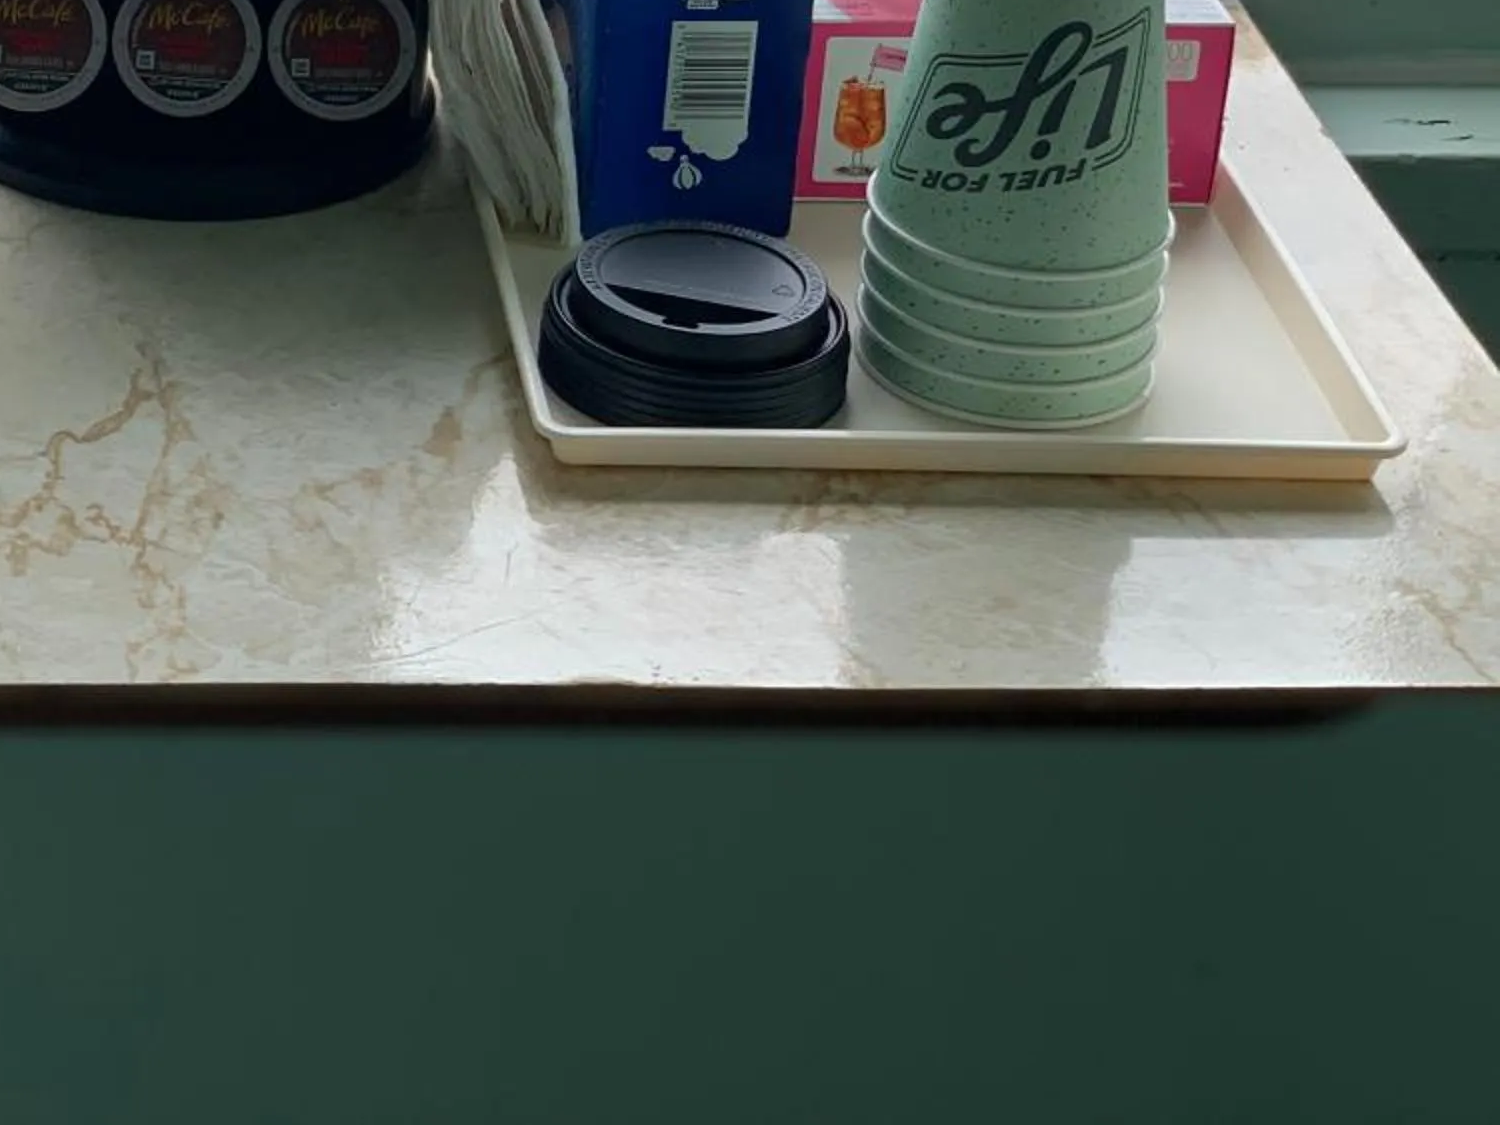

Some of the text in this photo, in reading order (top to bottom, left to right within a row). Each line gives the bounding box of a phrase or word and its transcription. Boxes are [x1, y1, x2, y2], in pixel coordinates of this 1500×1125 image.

[926, 21, 1129, 167] Life
[921, 158, 1086, 193] FUEL FOR
